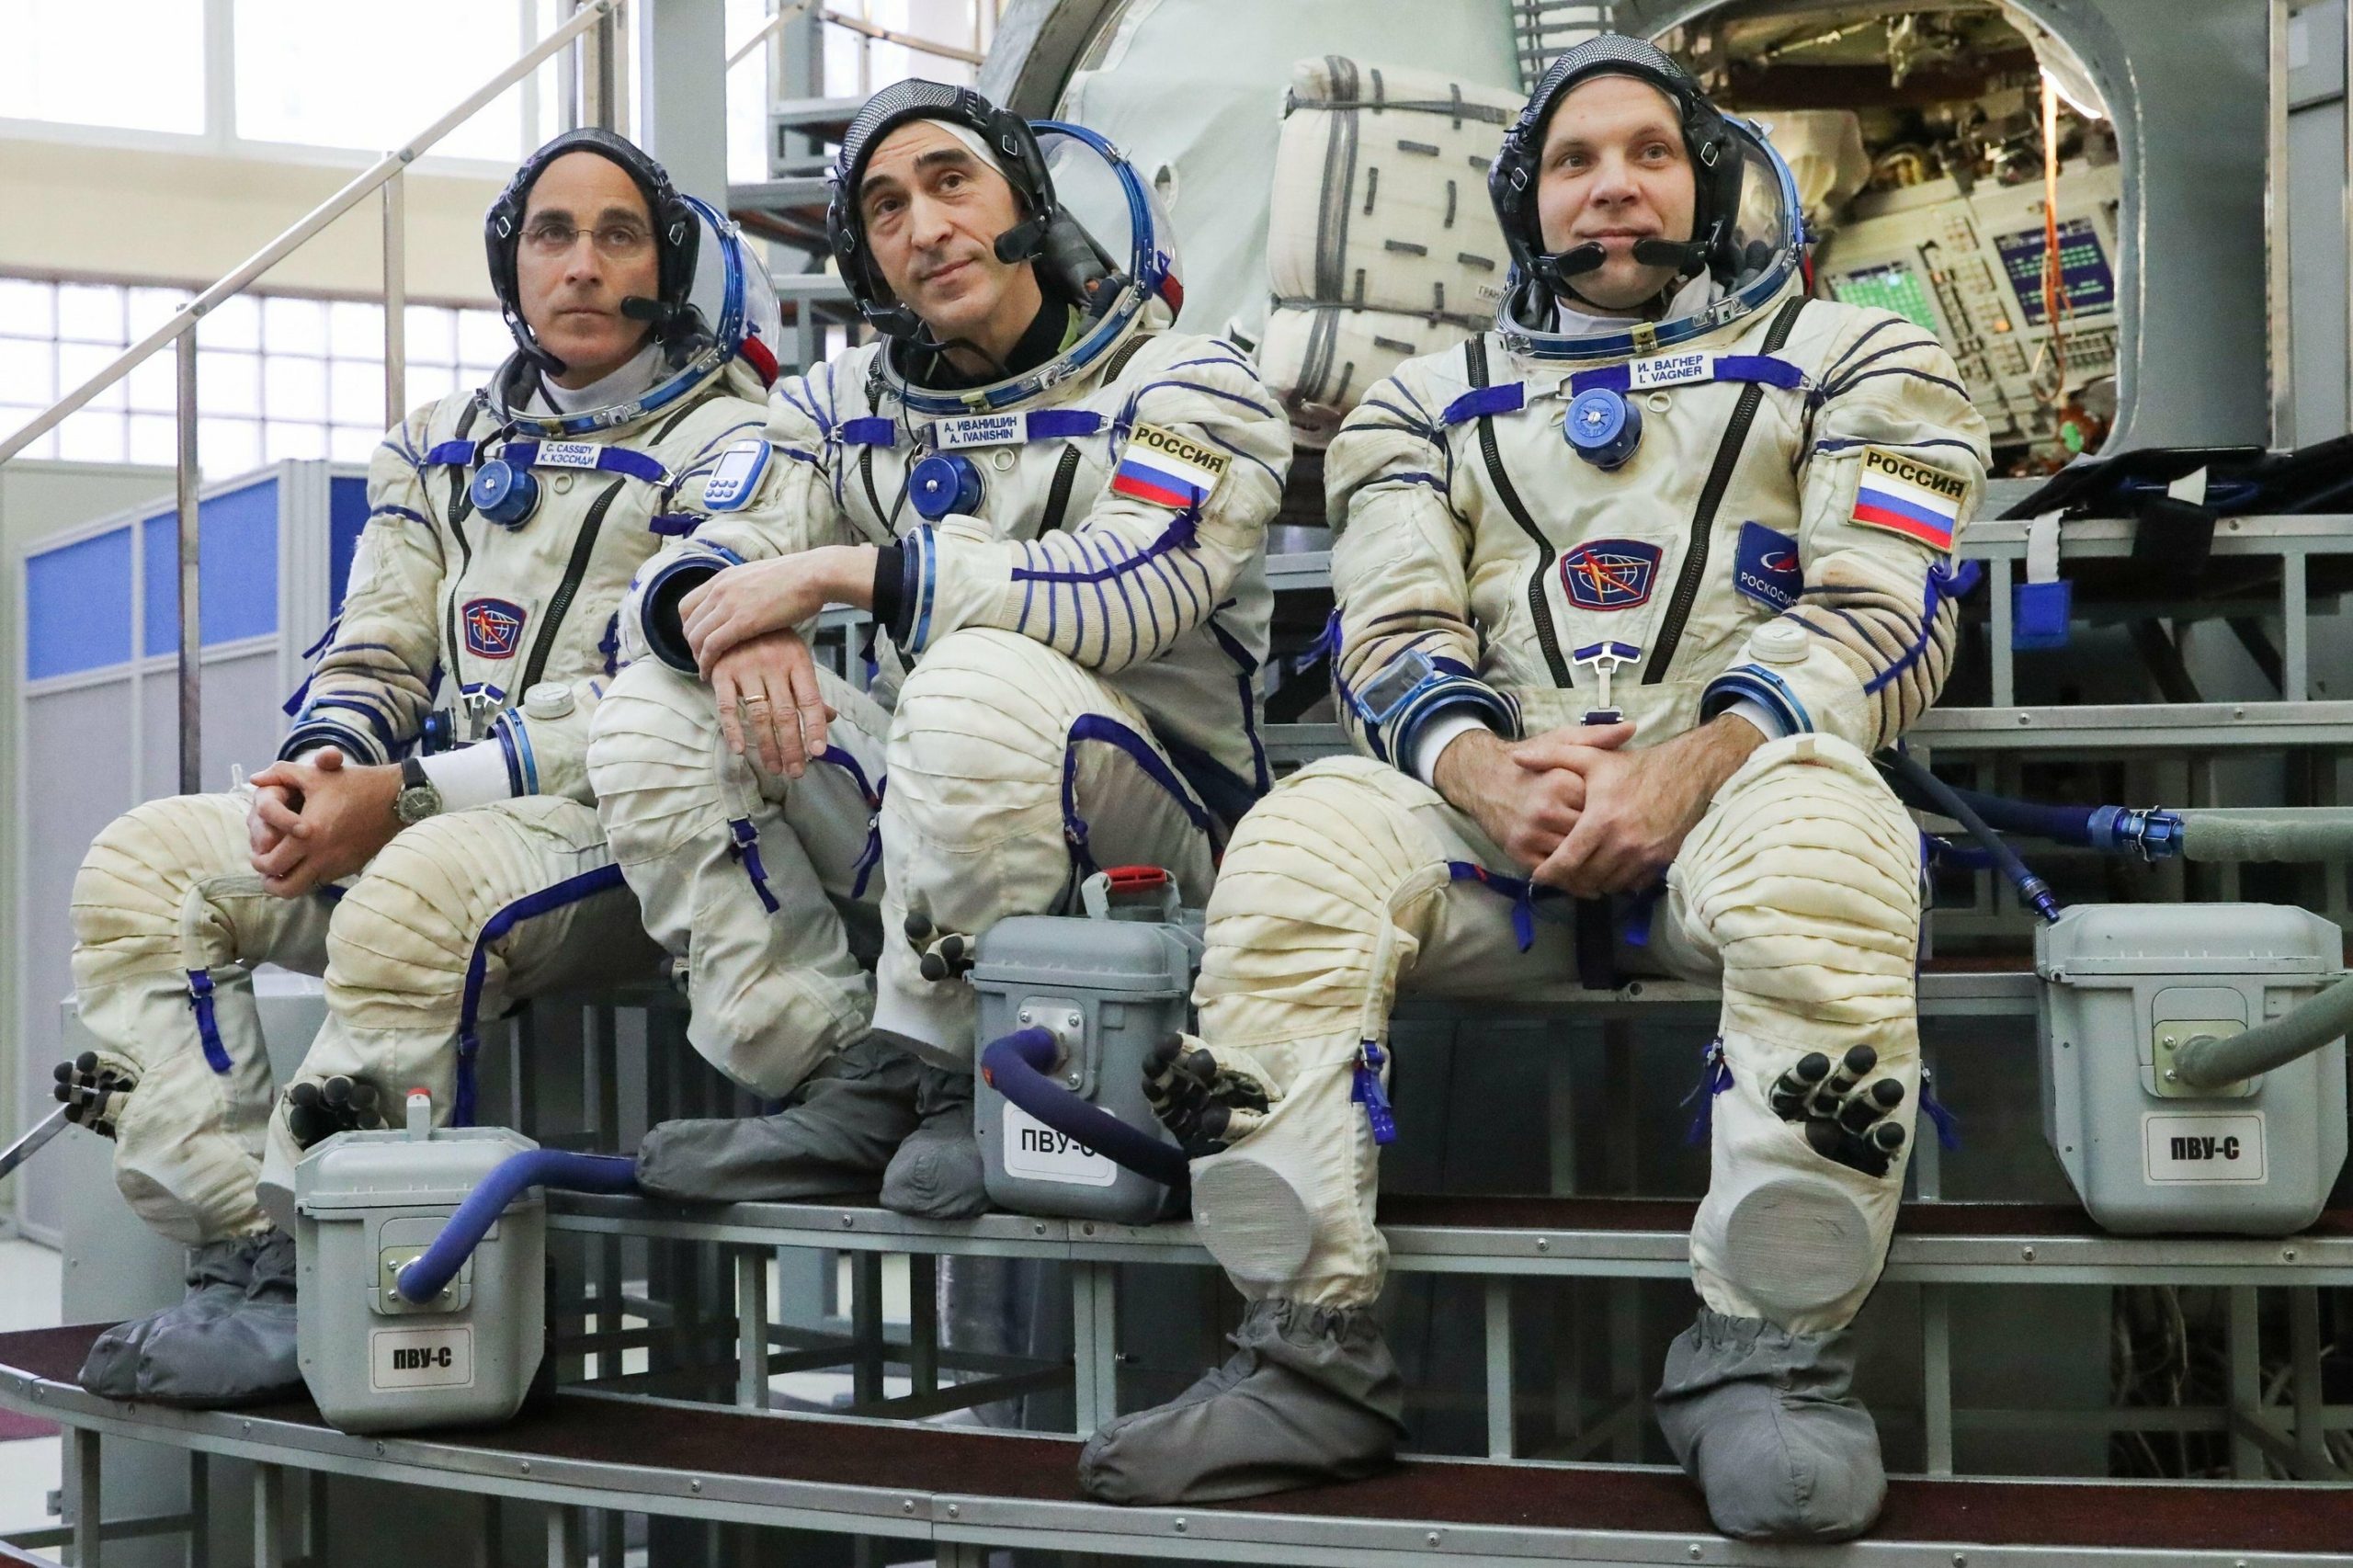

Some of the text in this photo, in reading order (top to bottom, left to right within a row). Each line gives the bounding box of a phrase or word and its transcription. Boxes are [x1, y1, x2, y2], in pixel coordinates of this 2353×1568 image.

[1637, 355, 1704, 373] И. ВАГНЕР
[1639, 366, 1702, 384] I. VAGNER
[944, 416, 1017, 433] А. ИВАНИШИН
[949, 428, 1014, 443] A. IVANISHIN
[546, 443, 594, 455] C. CASSIDY
[1134, 426, 1224, 473] РОССИЯ
[540, 453, 595, 466] К. КЭССИДИ
[1866, 450, 1965, 497] РОССИЯ
[2170, 1135, 2240, 1161] ПВУ-С
[393, 1346, 452, 1370] ПВУ-С
